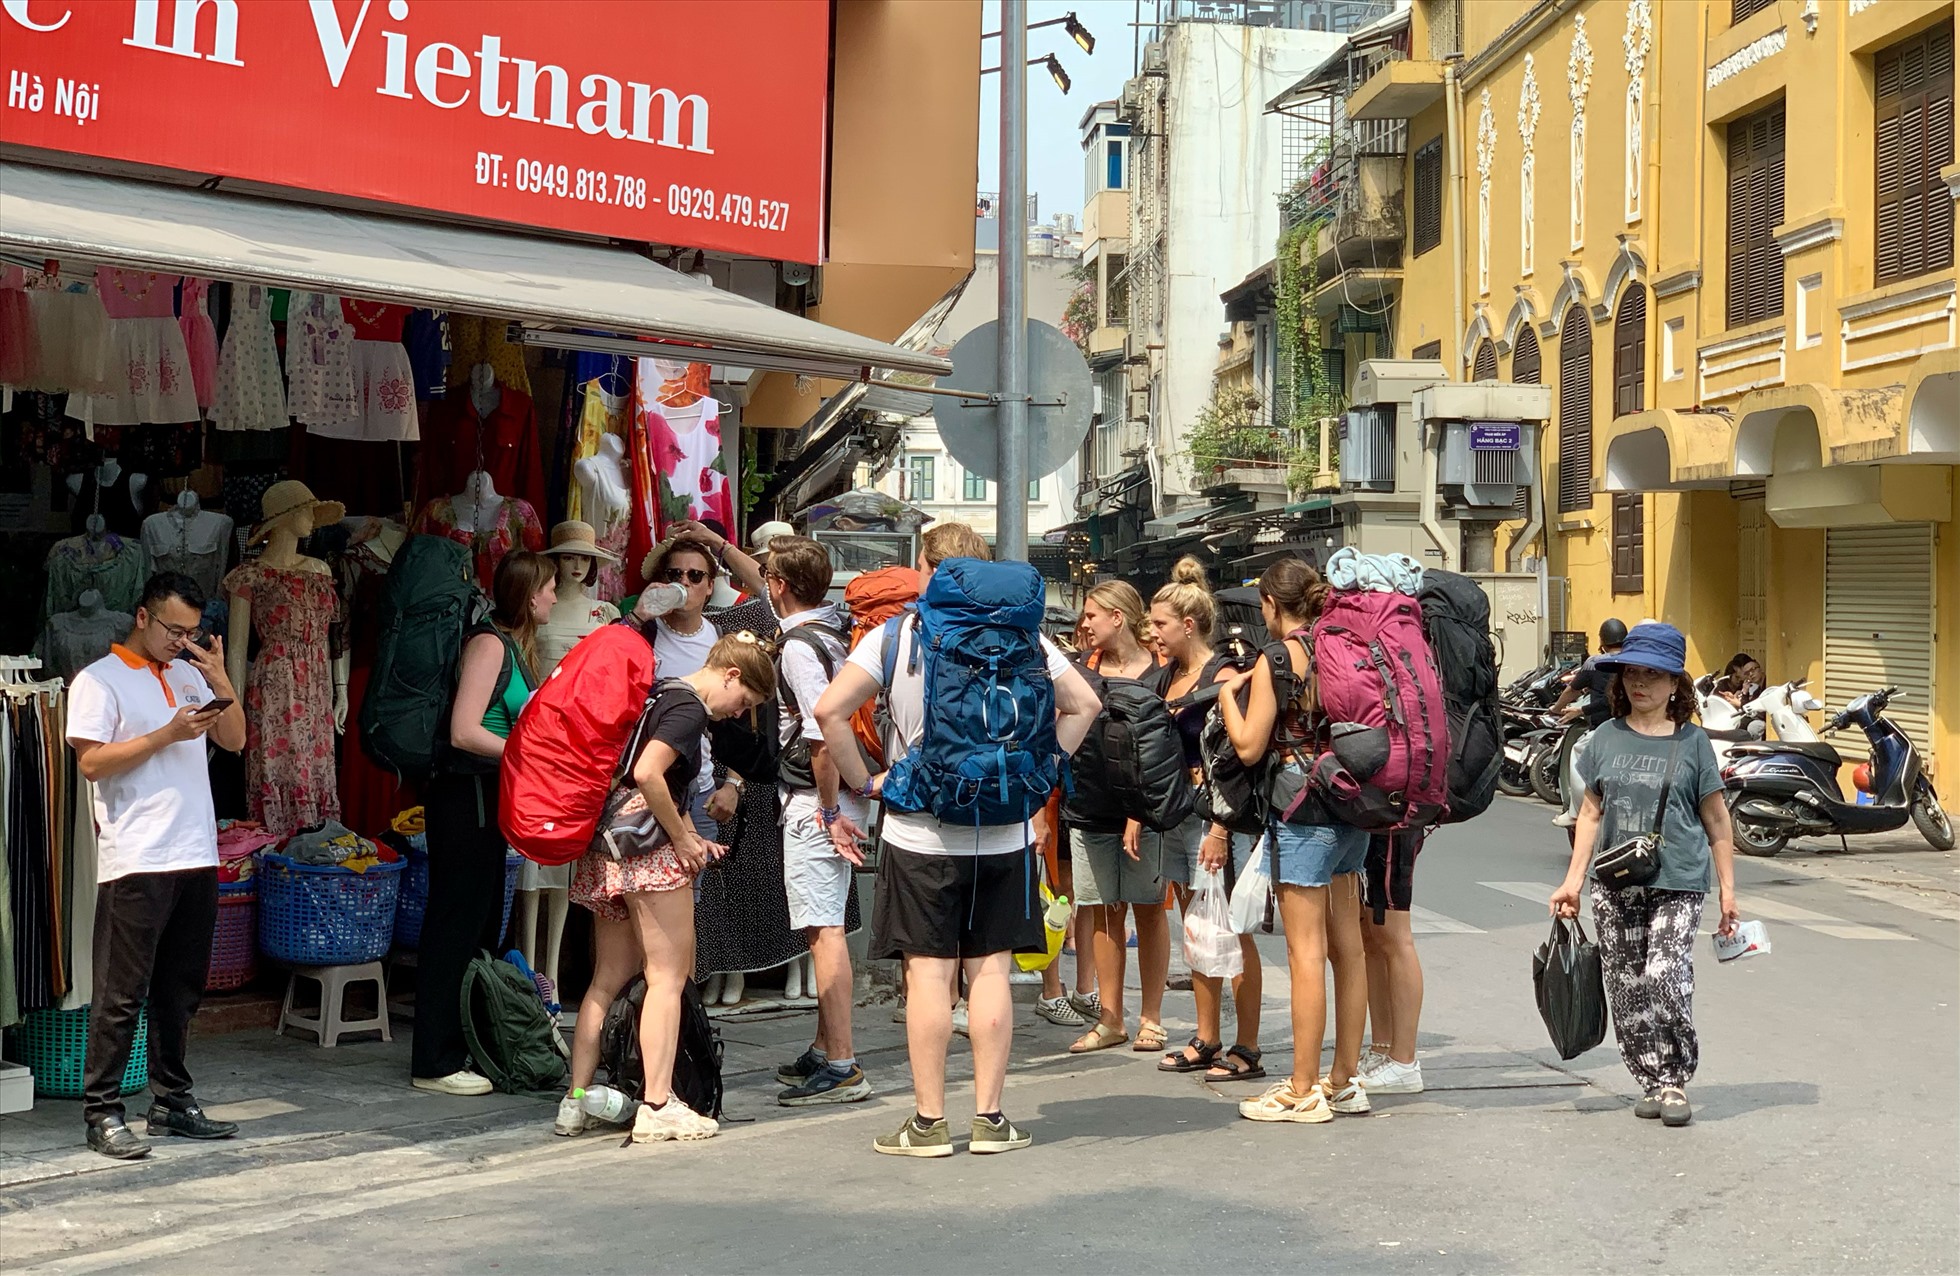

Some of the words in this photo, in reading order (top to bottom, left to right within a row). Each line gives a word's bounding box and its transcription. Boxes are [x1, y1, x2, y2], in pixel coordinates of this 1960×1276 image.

[8, 69, 45, 113] Hà
[54, 77, 99, 126] Nội
[308, 0, 714, 155] Vietnam
[474, 151, 509, 190] ĐT:
[515, 158, 647, 210] 0949.813.788
[667, 183, 790, 232] 0929.479.527
[1612, 754, 1633, 769] LED
